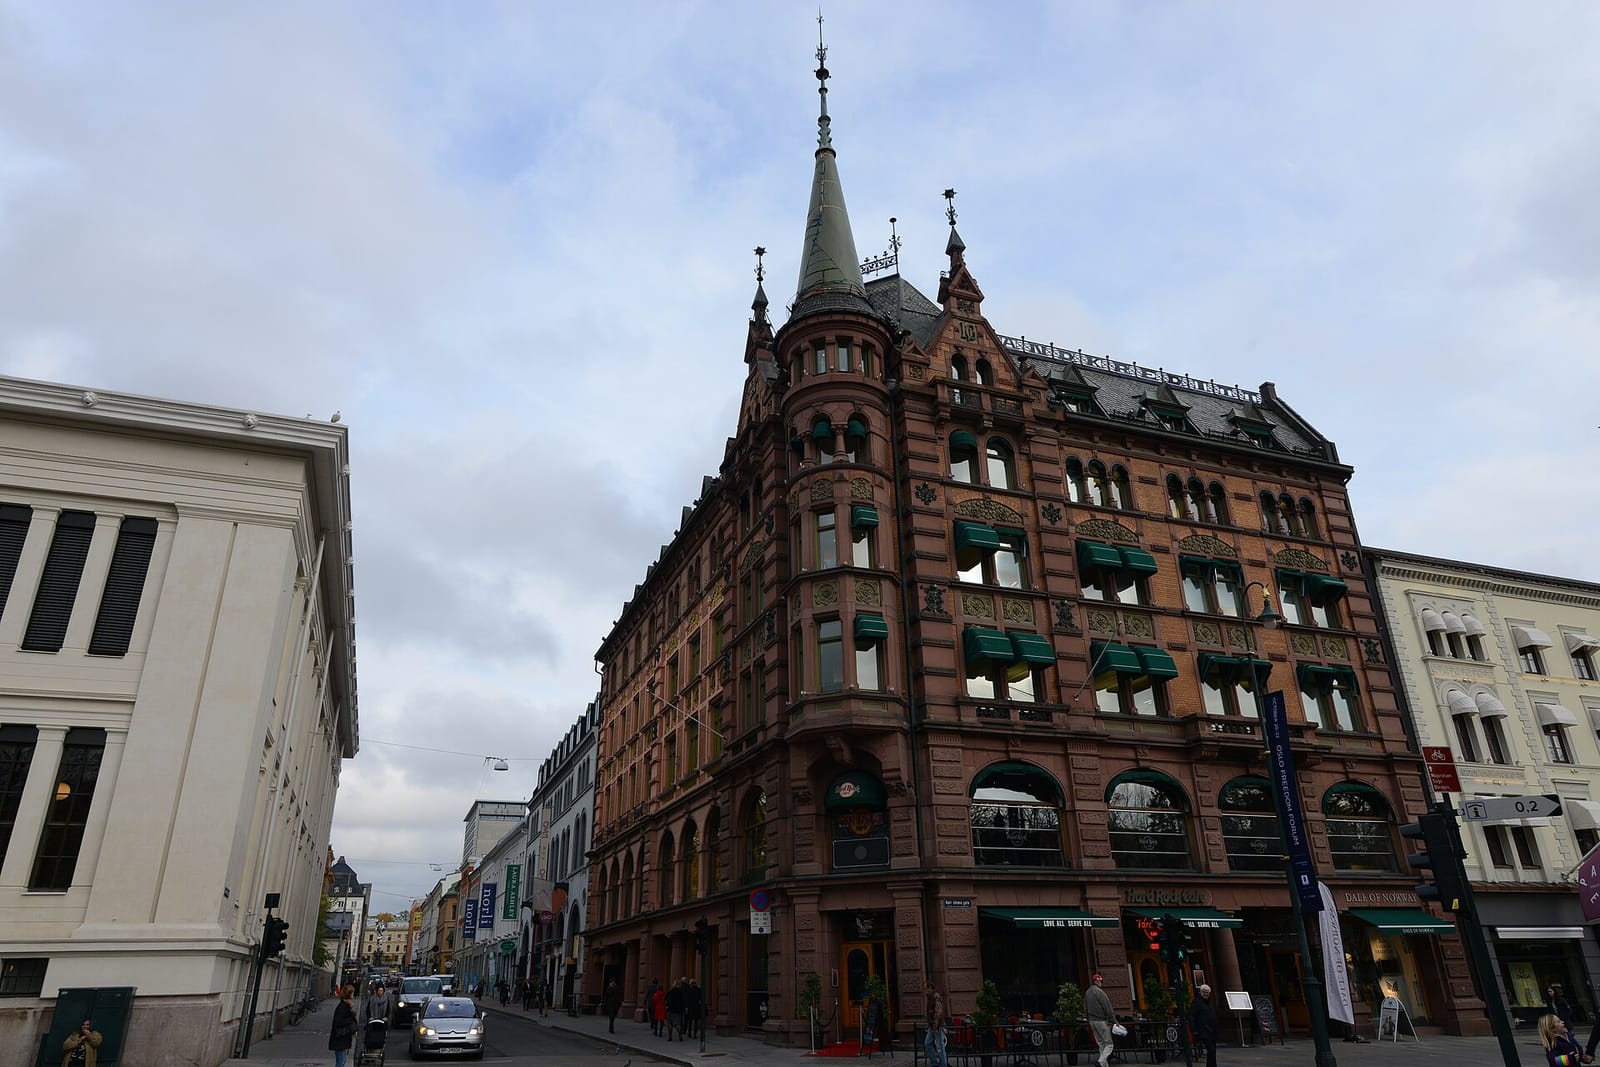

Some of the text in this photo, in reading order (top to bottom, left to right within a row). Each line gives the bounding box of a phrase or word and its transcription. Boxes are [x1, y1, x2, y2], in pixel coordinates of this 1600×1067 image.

[1276, 744, 1300, 846] OSLO FREEDOM FORUM
[1515, 800, 1539, 813] 0,2
[481, 889, 493, 924] norli
[508, 891, 516, 918] ASHLEY
[1127, 888, 1153, 904] Hard
[1156, 887, 1182, 906] Rock
[1345, 892, 1367, 902] DALE
[1368, 892, 1380, 903] OF
[465, 903, 476, 934] norli
